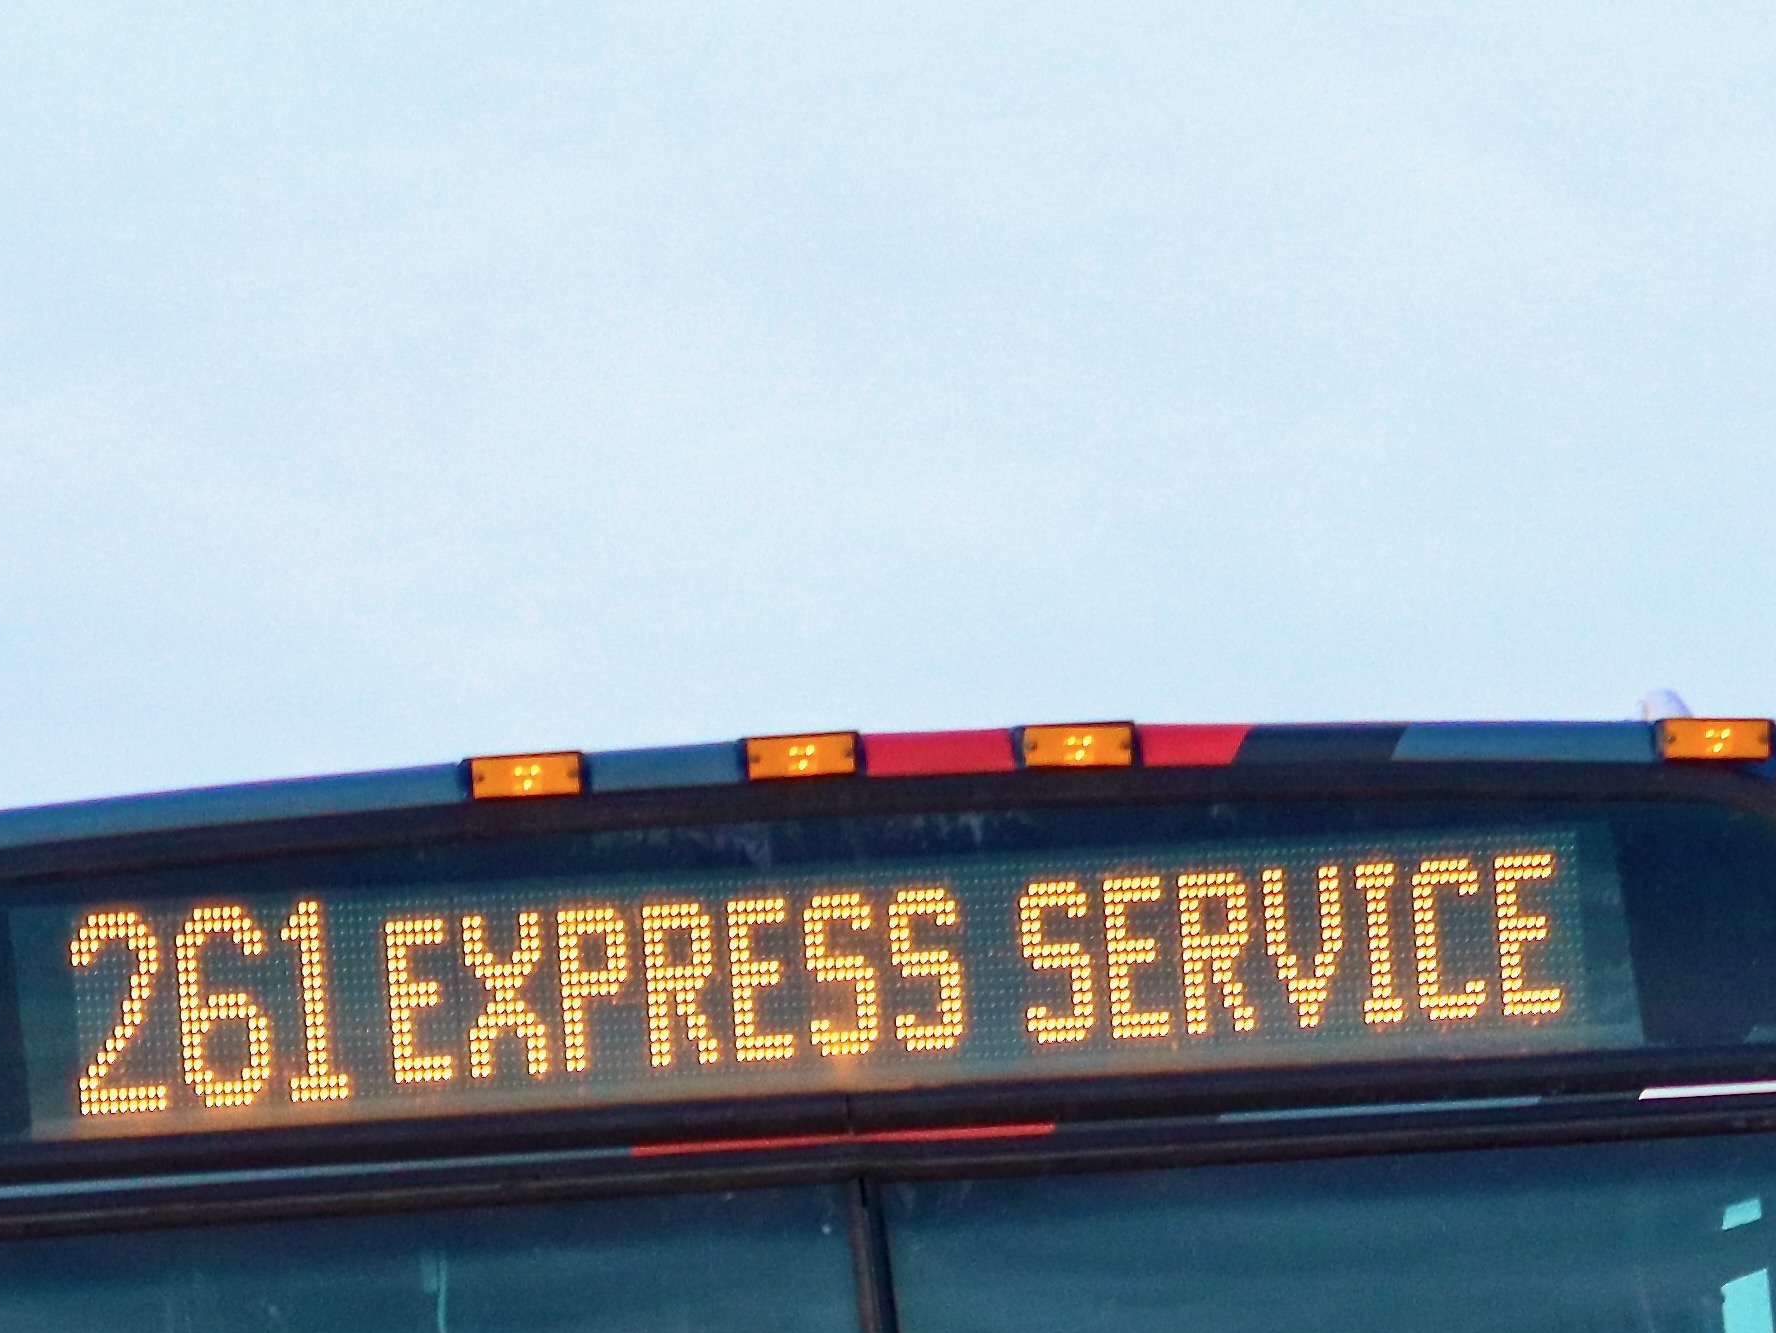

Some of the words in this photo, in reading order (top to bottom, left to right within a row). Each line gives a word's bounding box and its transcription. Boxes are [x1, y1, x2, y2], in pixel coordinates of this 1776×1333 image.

[70, 900, 350, 1115] 261
[384, 888, 963, 1085] EXPRESS
[1019, 853, 1563, 1044] SERVICE
